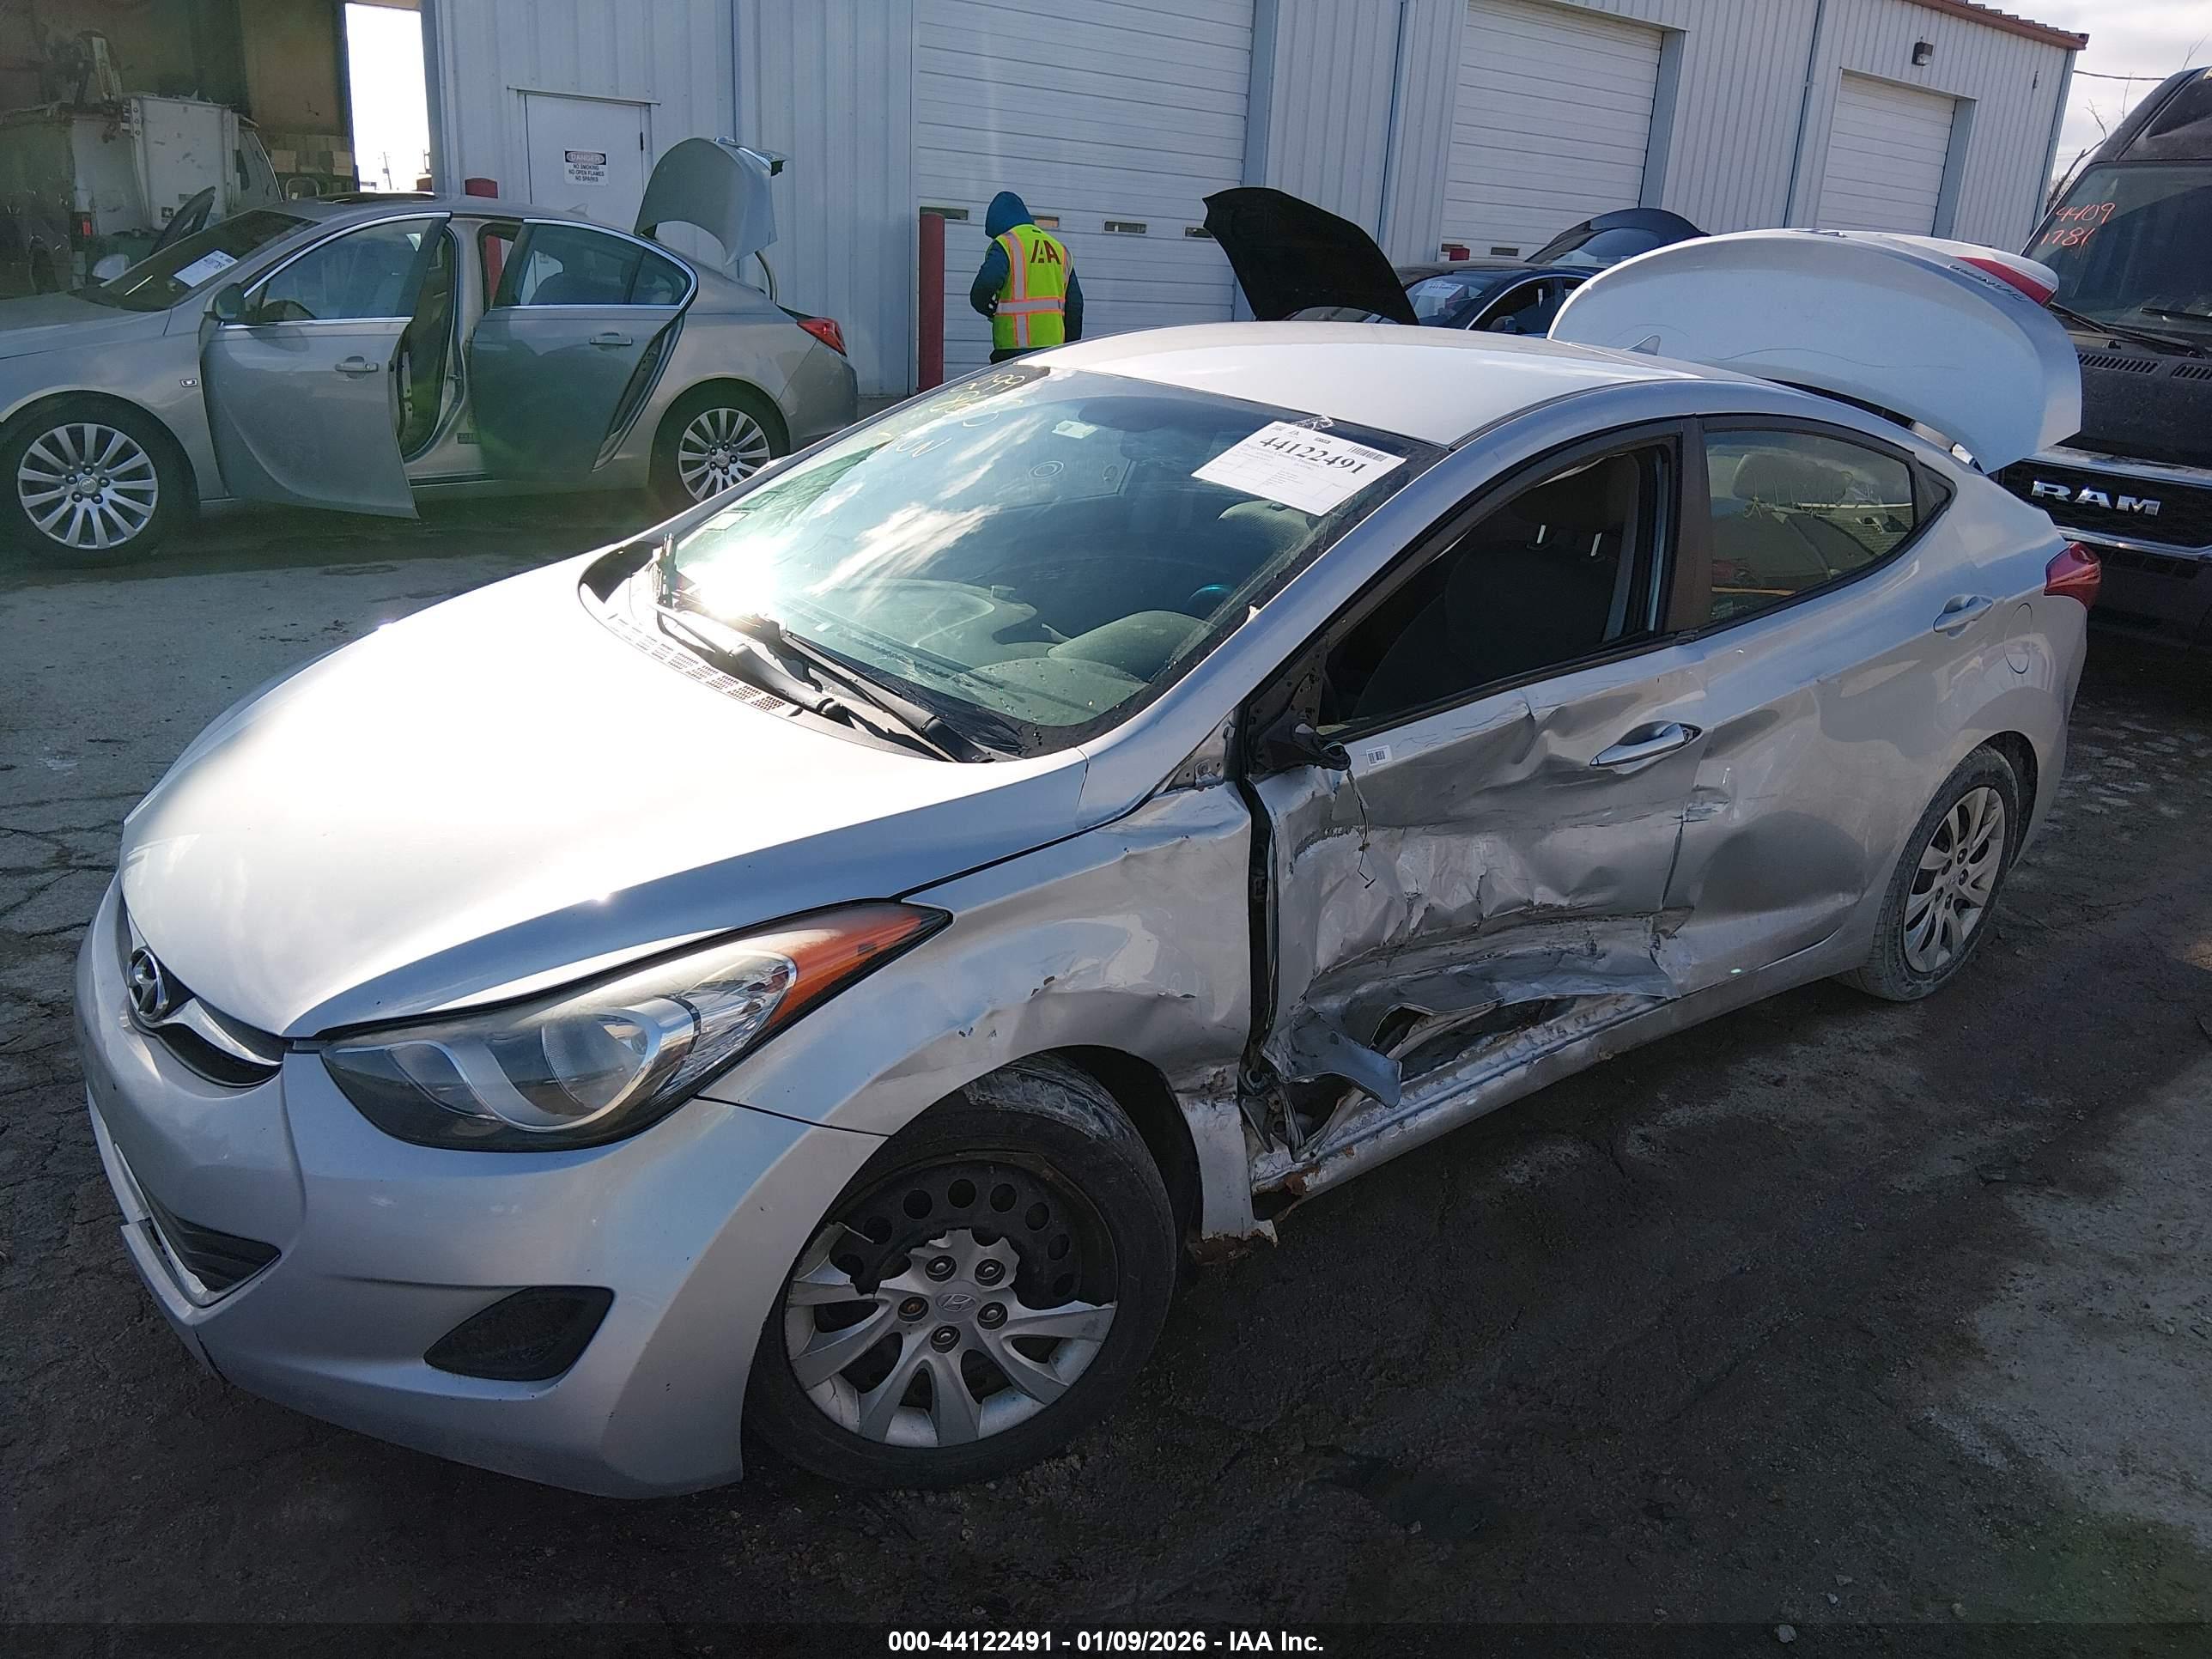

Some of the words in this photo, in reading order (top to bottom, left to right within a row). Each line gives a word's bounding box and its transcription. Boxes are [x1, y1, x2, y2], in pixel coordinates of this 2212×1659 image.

[571, 154, 599, 162] DANGER
[2056, 202, 2116, 225] 4409
[2040, 227, 2095, 247] 1781
[1260, 436, 1368, 474] 44122491
[2031, 481, 2161, 516] RAM
